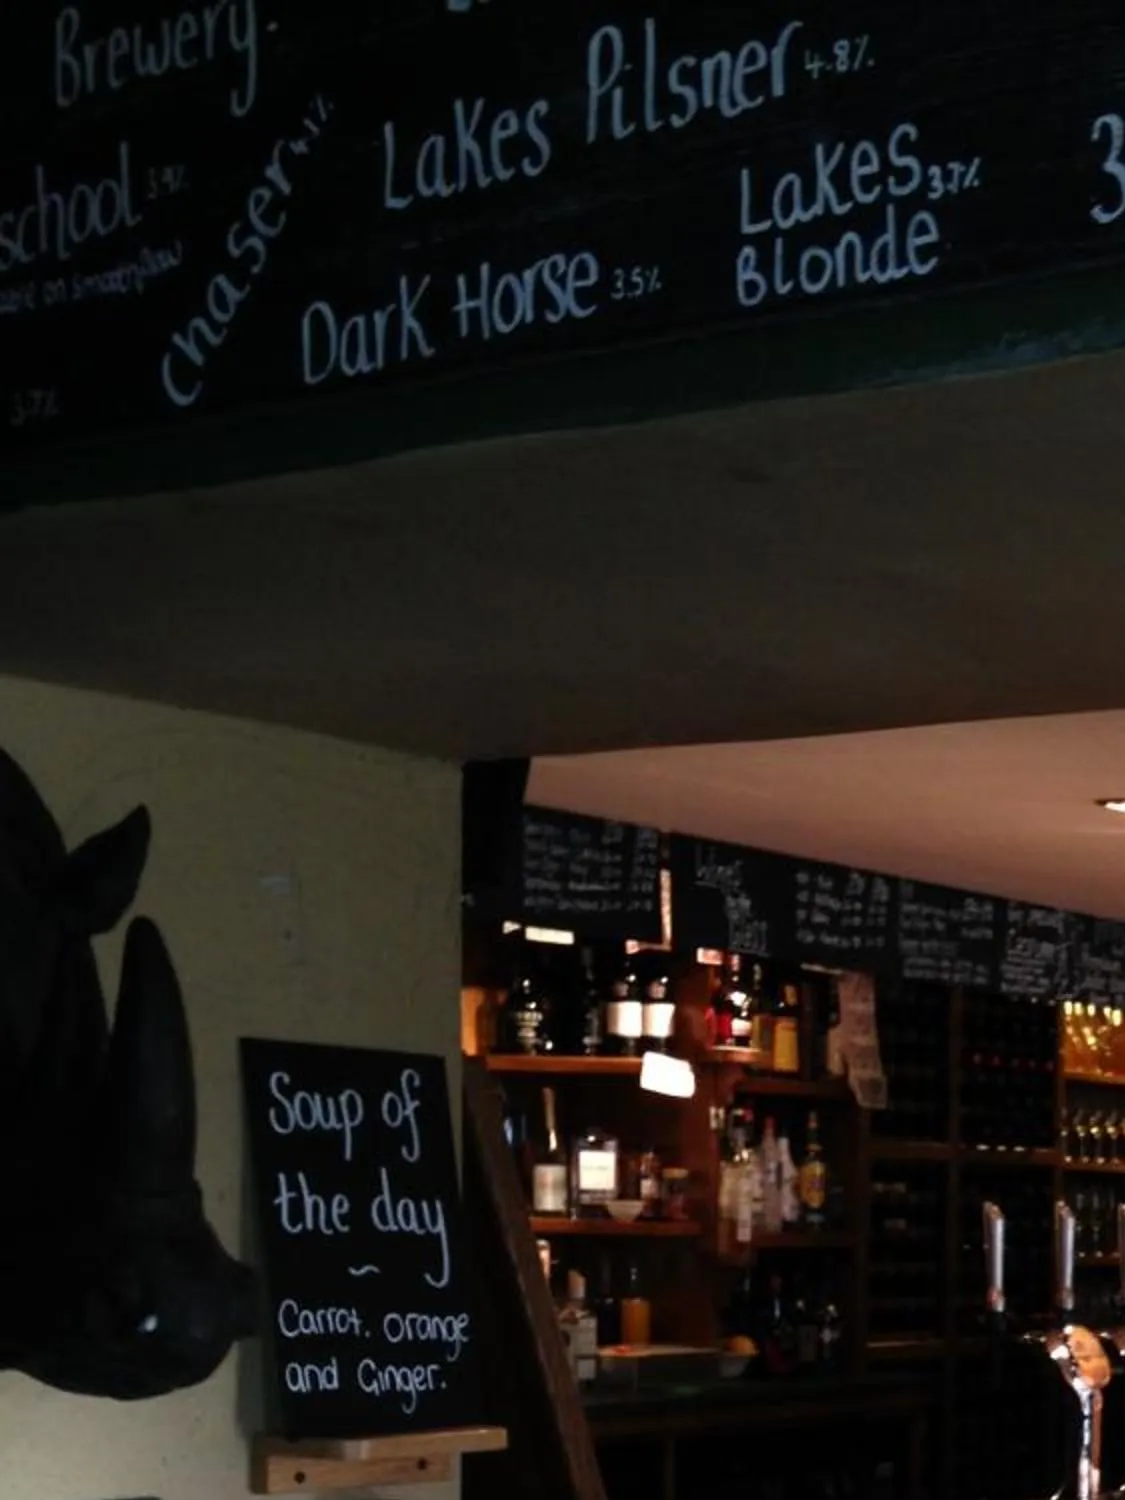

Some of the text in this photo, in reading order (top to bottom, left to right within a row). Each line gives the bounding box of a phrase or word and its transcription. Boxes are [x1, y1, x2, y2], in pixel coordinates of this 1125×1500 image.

[384, 97, 551, 209] Lakes
[587, 18, 804, 143] Pilsner
[737, 203, 940, 306] Blonde
[300, 273, 436, 385] Dark
[453, 250, 599, 341] Horse
[269, 1068, 422, 1162] Soup of
[274, 1167, 449, 1288] the day
[285, 1356, 339, 1393] and
